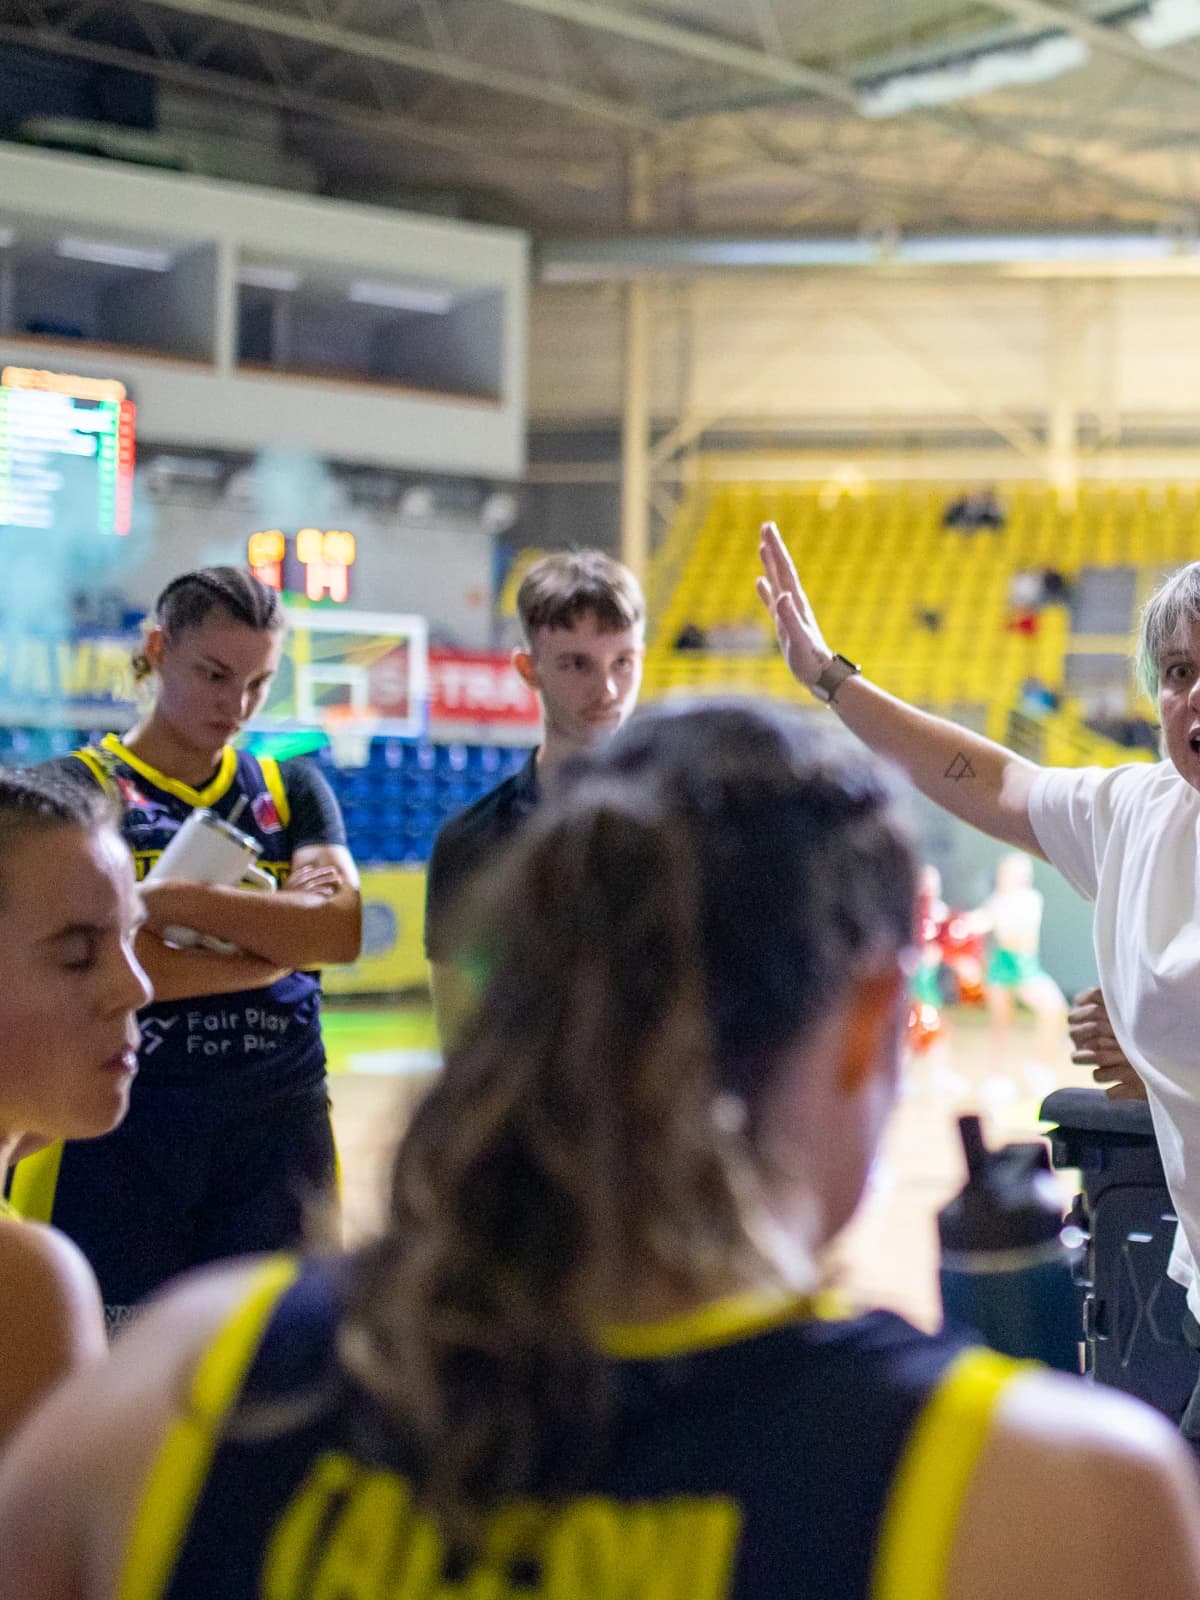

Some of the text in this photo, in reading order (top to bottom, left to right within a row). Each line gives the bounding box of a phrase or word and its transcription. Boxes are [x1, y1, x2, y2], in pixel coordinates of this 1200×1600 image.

[187, 1007, 291, 1034] Fair Play
[187, 1034, 232, 1056] For
